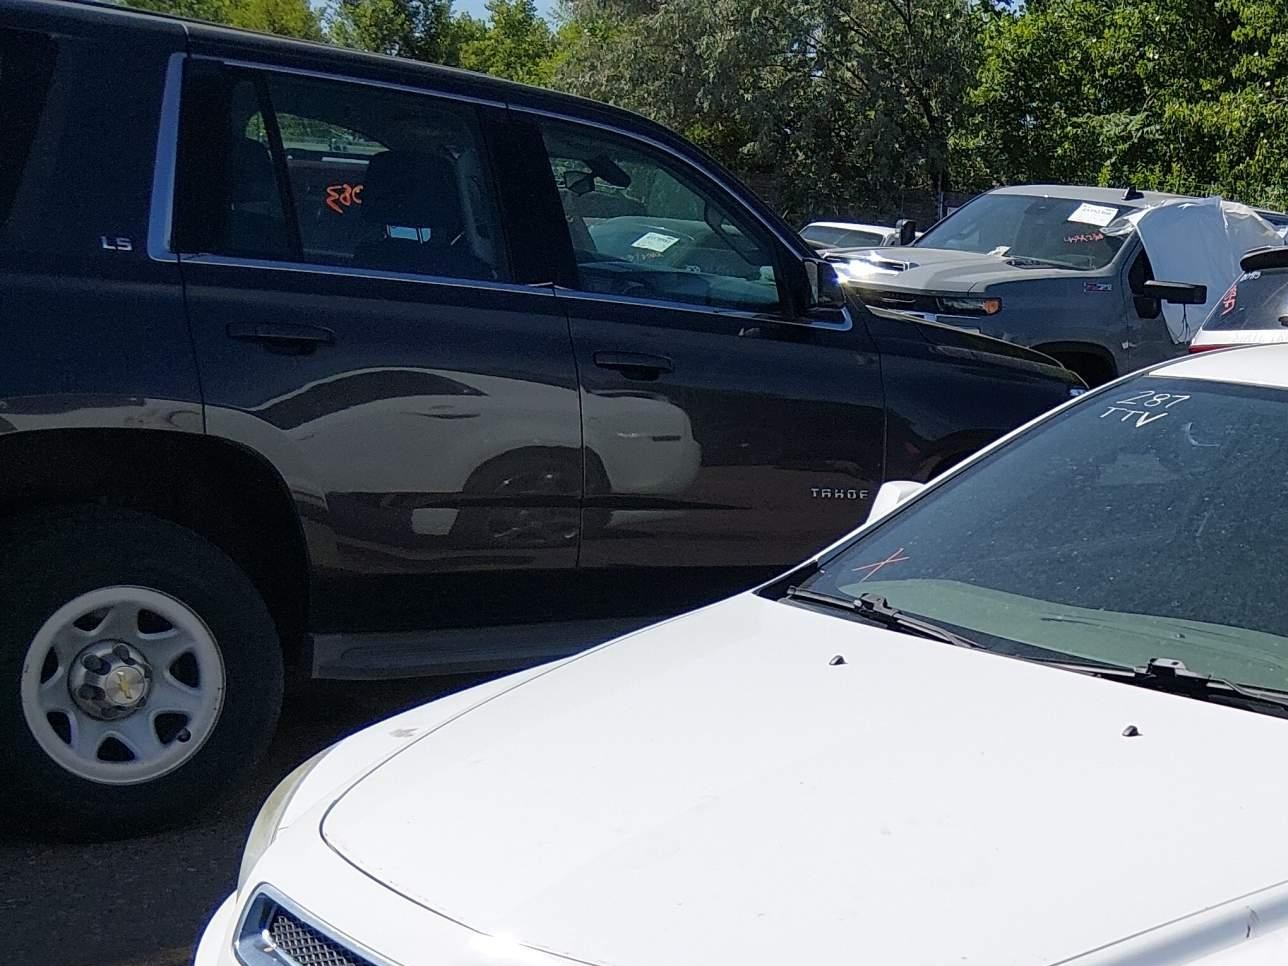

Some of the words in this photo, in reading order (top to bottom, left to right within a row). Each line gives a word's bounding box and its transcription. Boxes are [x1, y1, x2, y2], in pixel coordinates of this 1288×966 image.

[101, 236, 132, 250] LS
[1116, 390, 1191, 409] 287
[1099, 406, 1168, 428] TTV
[811, 488, 869, 499] TAHOE
